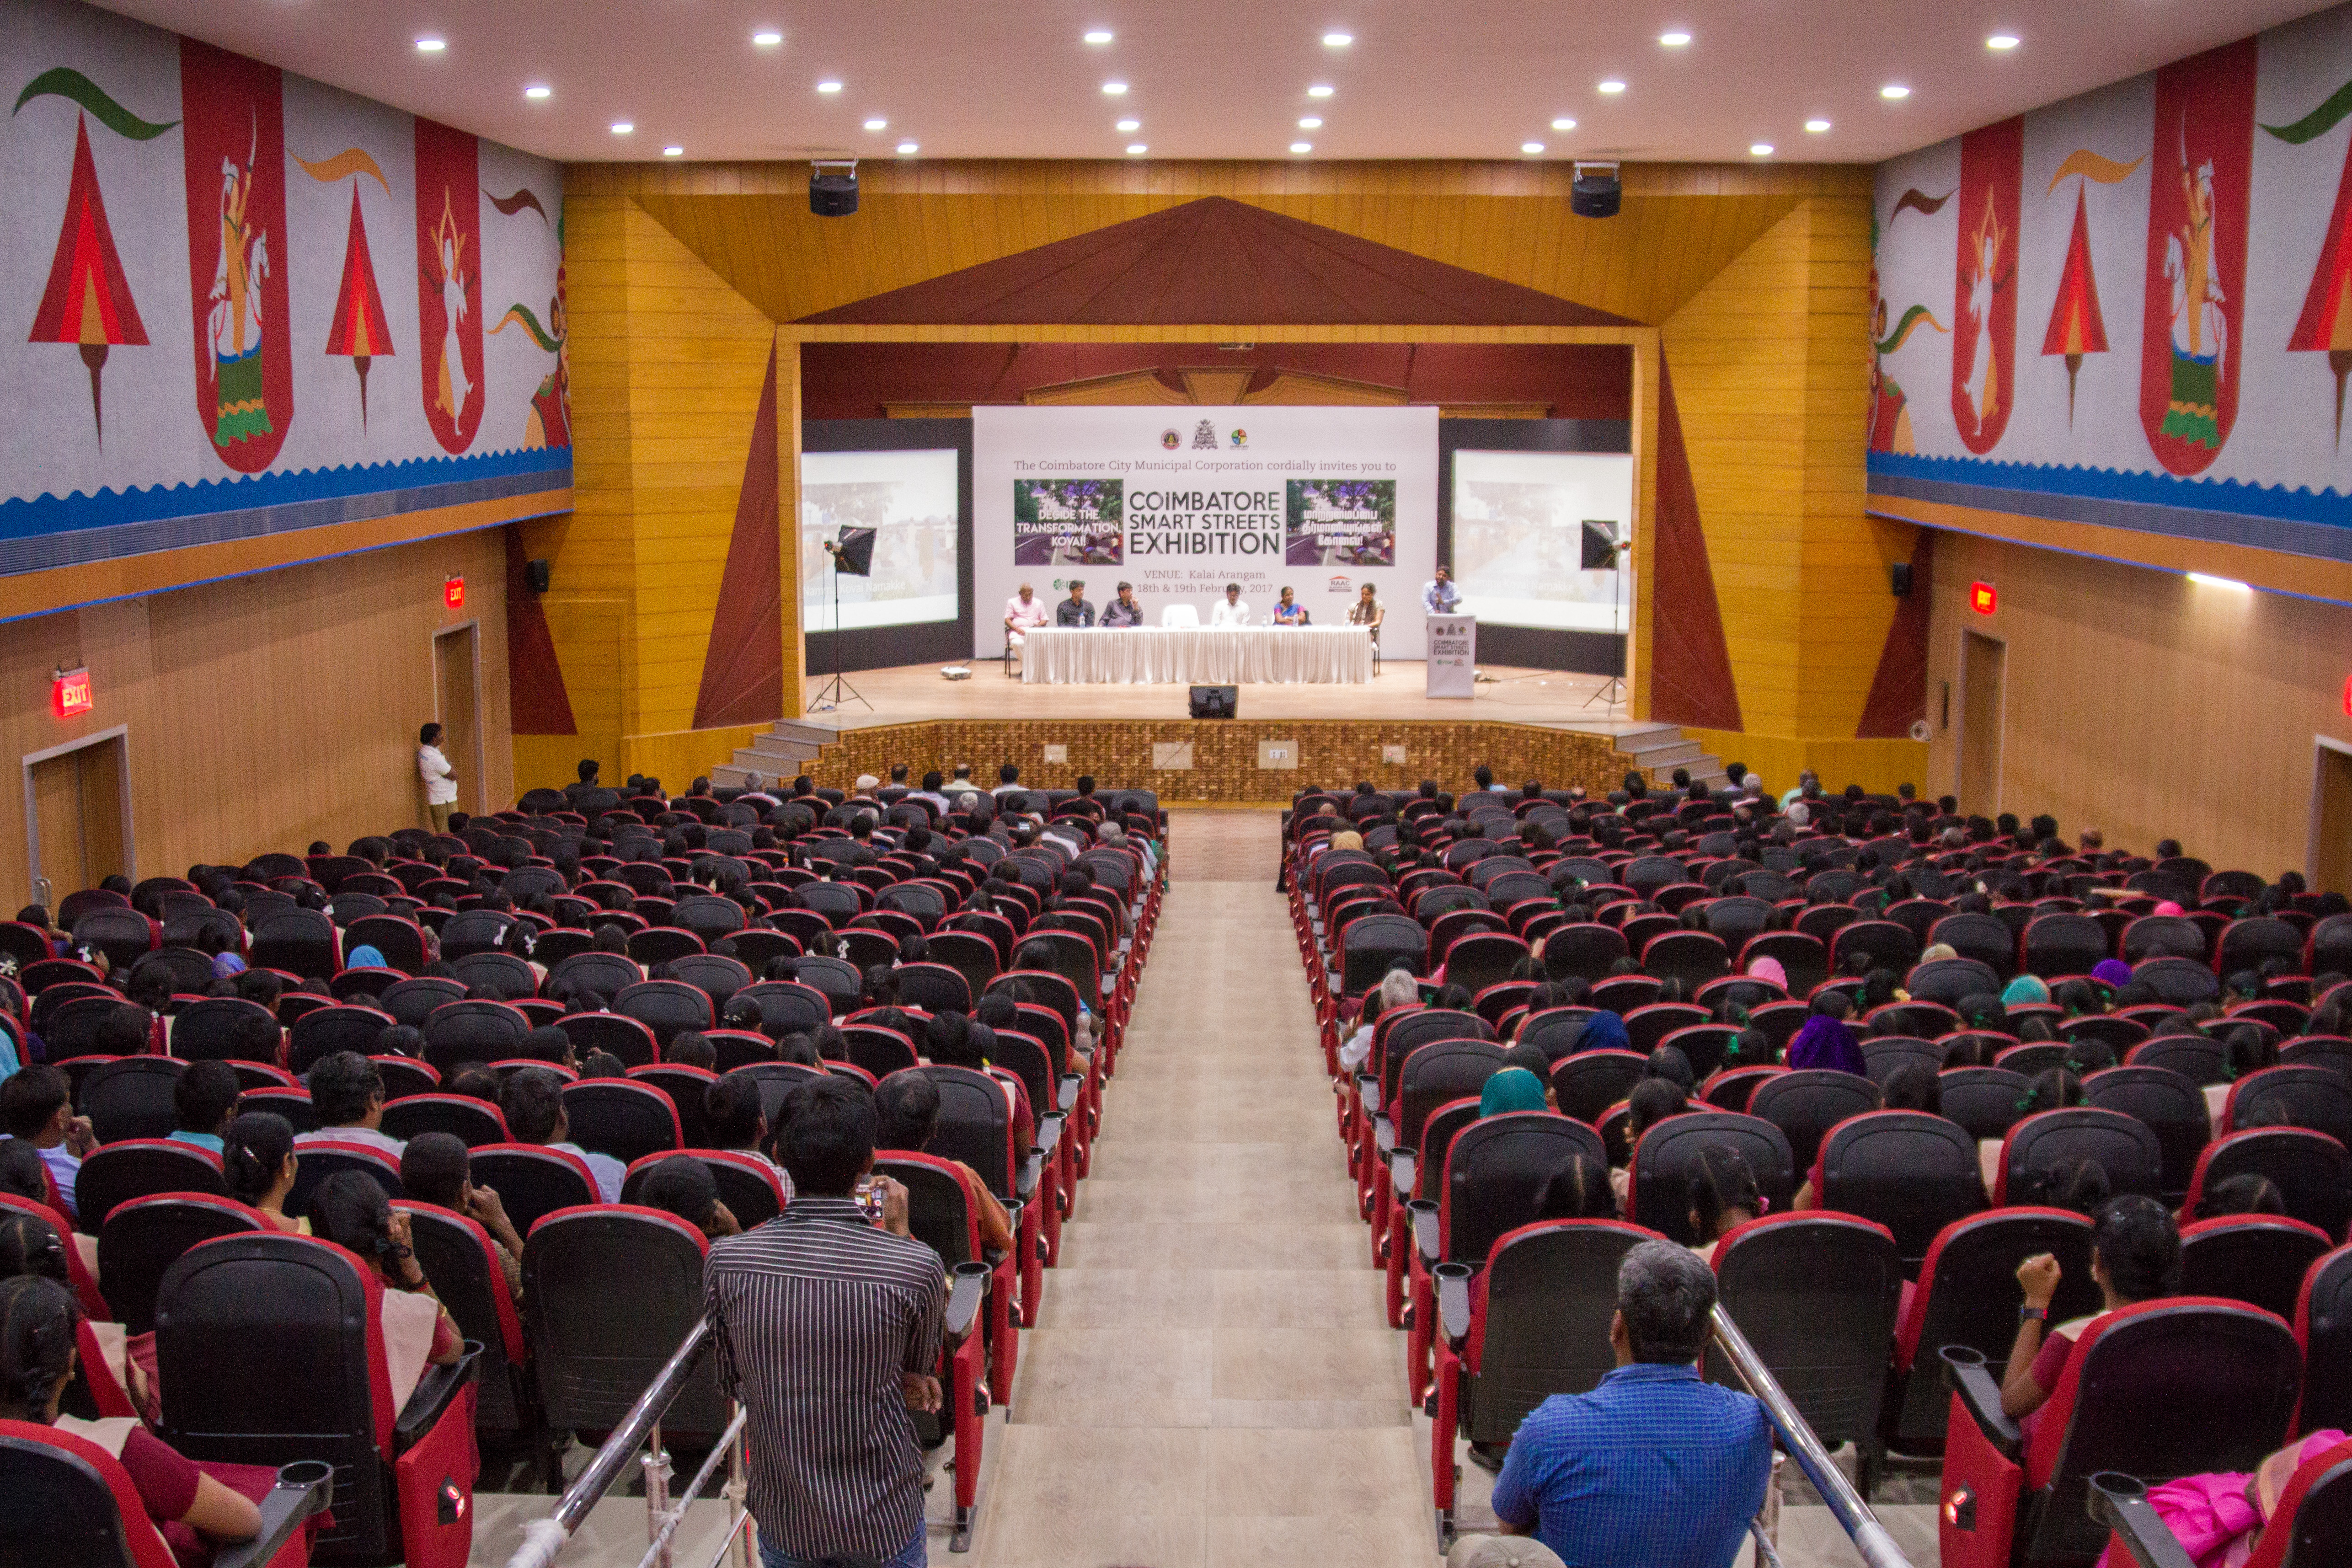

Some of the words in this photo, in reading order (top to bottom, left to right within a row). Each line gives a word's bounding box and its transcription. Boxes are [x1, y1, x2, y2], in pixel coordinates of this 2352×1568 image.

[1014, 460, 1036, 471] The
[1039, 460, 1105, 471] Coimbatore
[1108, 460, 1132, 473] City
[1135, 460, 1192, 473] Municipal
[1195, 460, 1263, 473] Corporation
[1267, 460, 1316, 473] cordially
[1320, 460, 1358, 471] invites
[1361, 463, 1382, 474] you
[1384, 462, 1397, 471] to
[1129, 491, 1280, 511] COIMBATORE
[1039, 510, 1076, 519] DECIDE
[1130, 514, 1195, 530] SMART
[1202, 514, 1280, 530] STREETS
[1052, 536, 1086, 546] KOVAI!
[1130, 532, 1280, 555] EXHIBITION
[1144, 570, 1183, 579] VENUE:
[1189, 570, 1215, 579] Kalai
[1218, 570, 1266, 582] Arangam
[450, 587, 462, 601] EXIT
[1137, 583, 1159, 593] 18th
[1163, 583, 1170, 593] &
[1175, 583, 1196, 593] 19th
[1200, 583, 1247, 595] Februy,
[1250, 584, 1273, 593] 2017
[62, 684, 86, 707] EXIT
